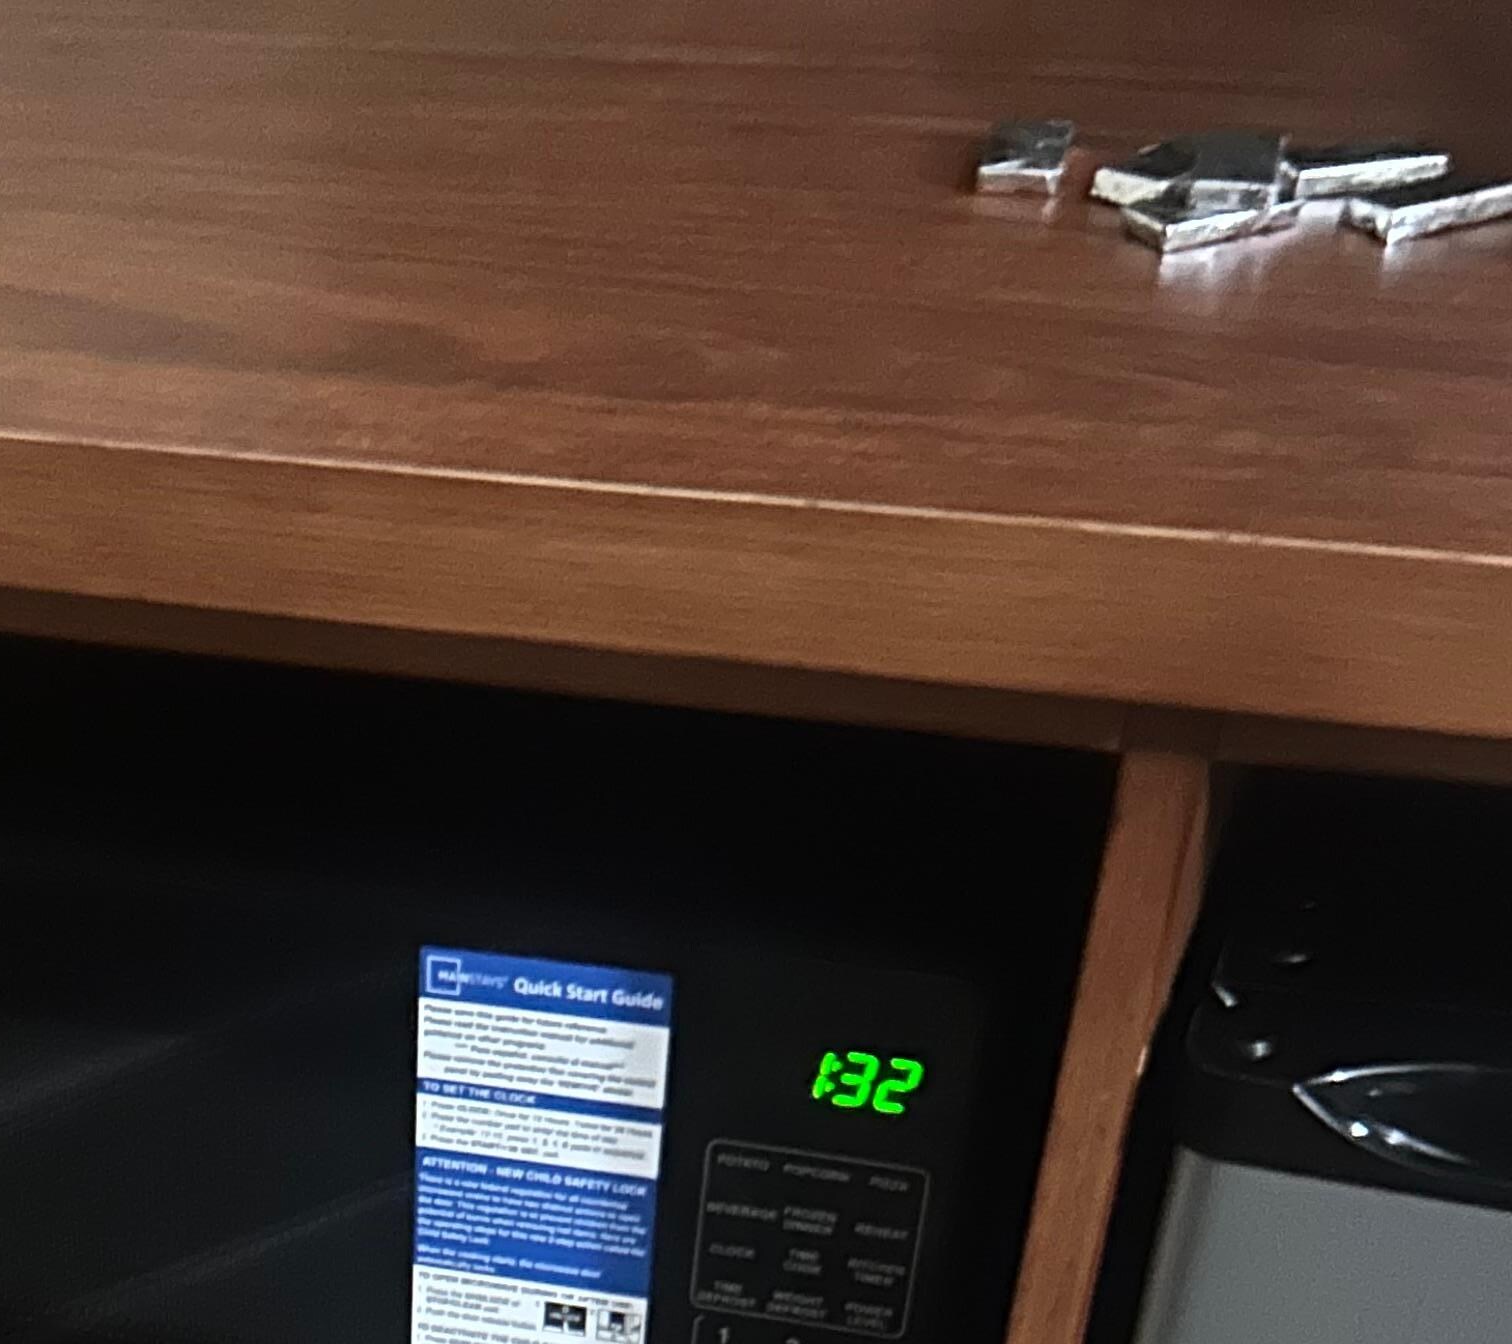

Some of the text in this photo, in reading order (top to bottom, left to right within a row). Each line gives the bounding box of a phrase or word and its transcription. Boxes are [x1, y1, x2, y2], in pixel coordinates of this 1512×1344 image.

[513, 976, 664, 1011] Quick Start Guide
[424, 1081, 439, 1093] TO
[442, 1083, 468, 1096] SET
[468, 1086, 491, 1099] THE
[494, 1089, 537, 1105] CLOCK
[812, 1052, 924, 1114] 1:32
[422, 1155, 487, 1175] ATTENTION
[496, 1165, 524, 1181] NEW
[526, 1168, 562, 1185] CHILD
[565, 1174, 611, 1192] SAFETY
[613, 1180, 648, 1197] LOCK
[719, 1327, 730, 1344] 1
